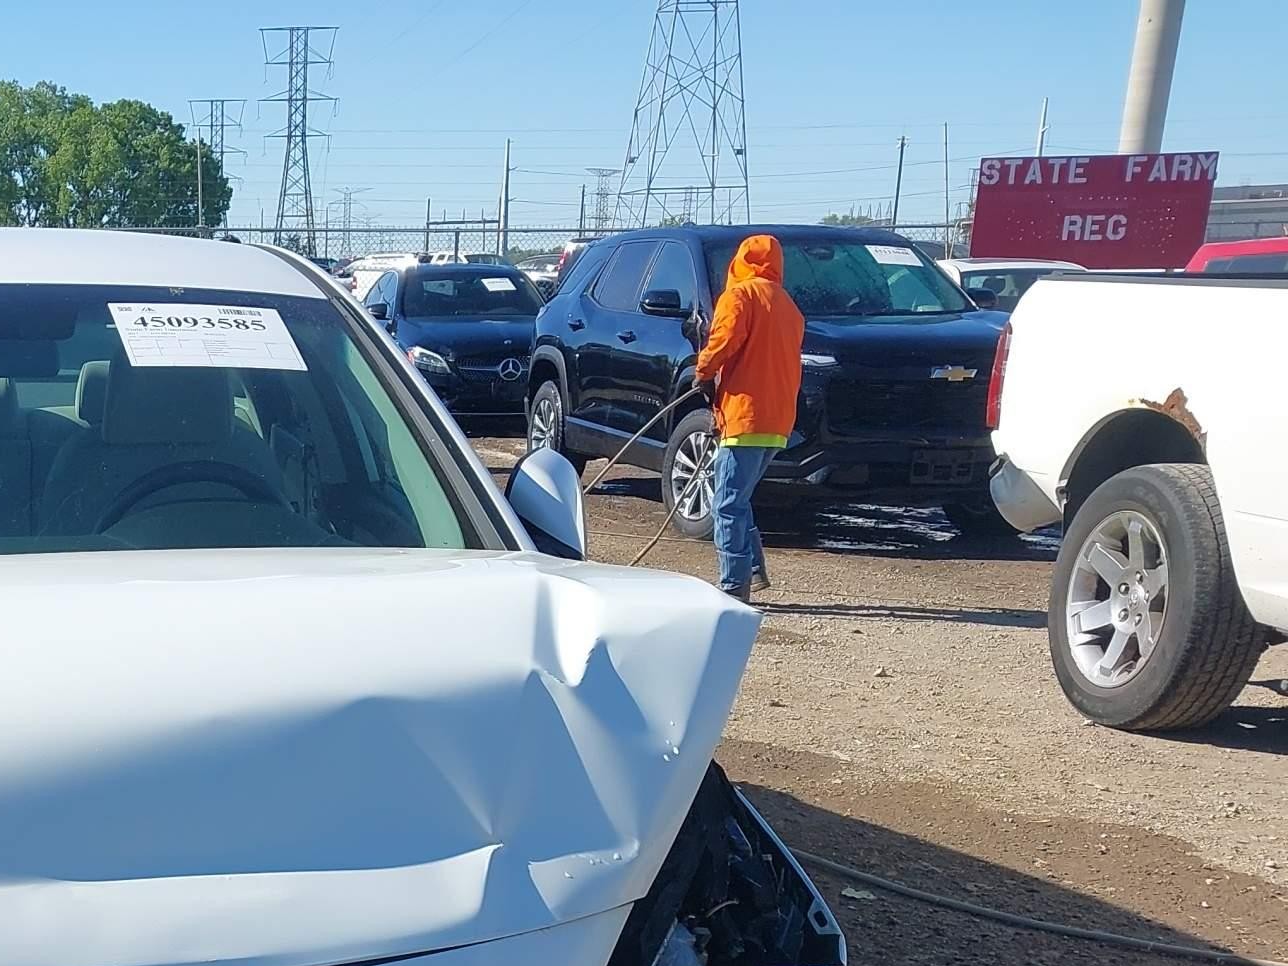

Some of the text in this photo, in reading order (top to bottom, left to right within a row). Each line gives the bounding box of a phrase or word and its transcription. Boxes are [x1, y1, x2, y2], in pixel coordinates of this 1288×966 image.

[981, 153, 1218, 184] STATE FARM
[1062, 214, 1127, 240] REG
[133, 316, 266, 331] 45093585
